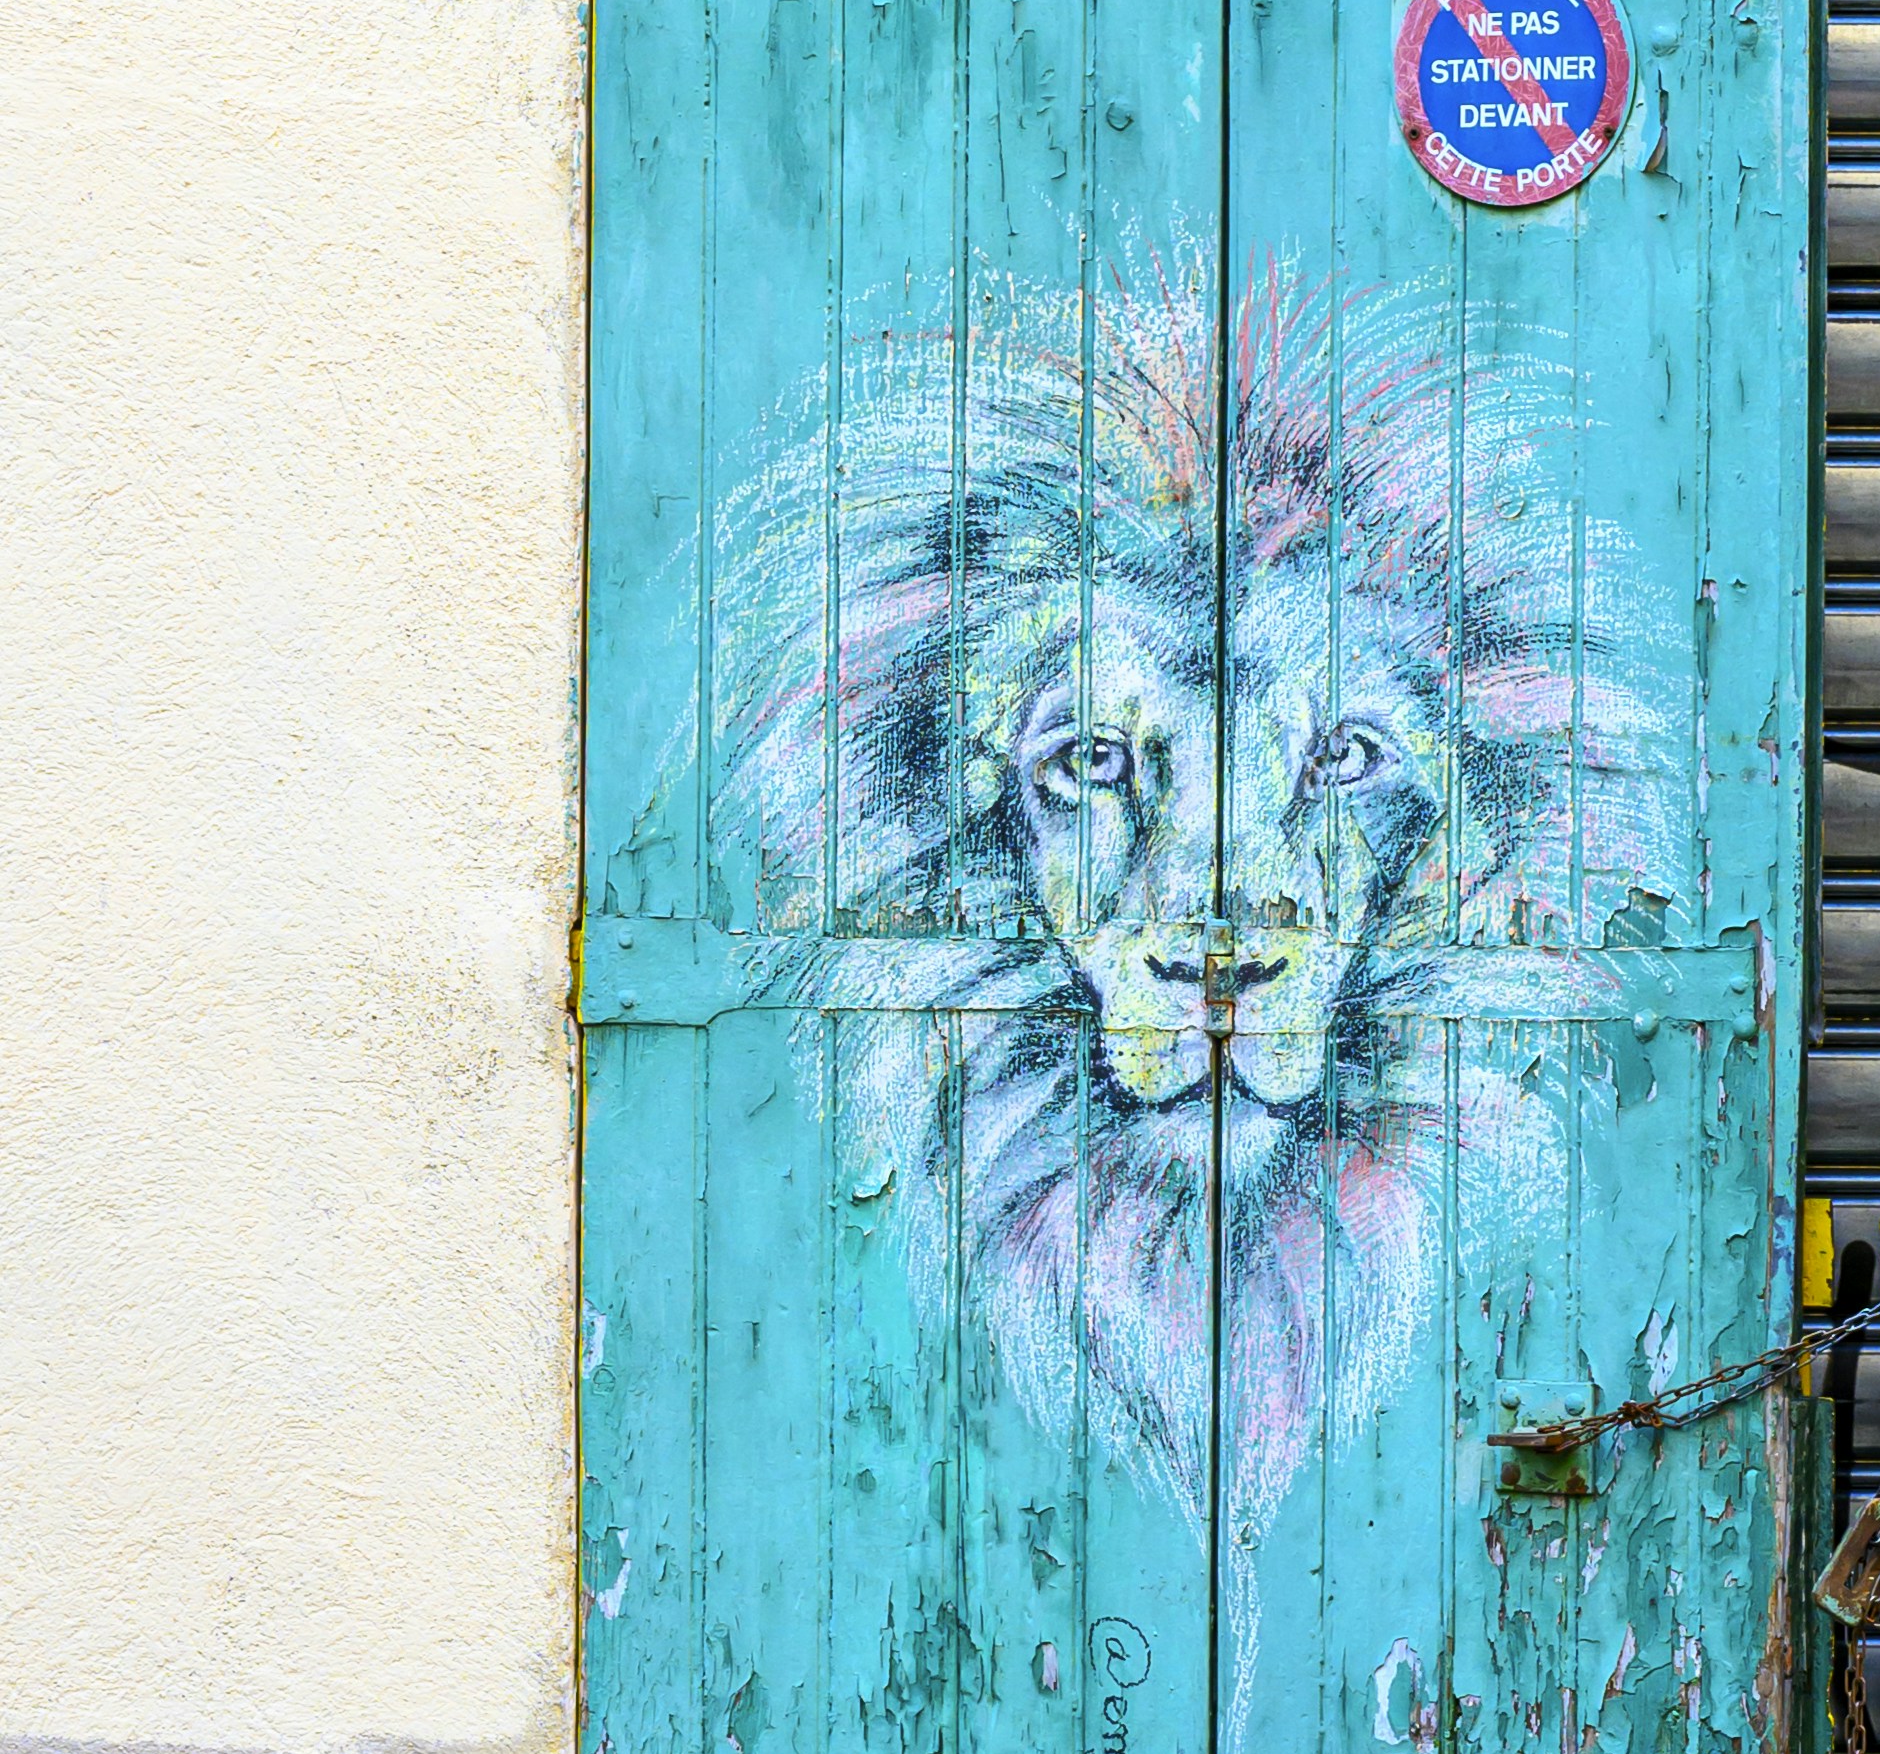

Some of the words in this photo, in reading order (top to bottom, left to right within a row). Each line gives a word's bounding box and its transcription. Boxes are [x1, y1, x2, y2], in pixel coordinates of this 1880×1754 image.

[1468, 12, 1503, 37] NE
[1510, 11, 1560, 36] PAS
[1430, 55, 1597, 84] STATIONNER
[1459, 102, 1569, 128] DEVANT
[1425, 131, 1503, 193] CETTE
[1516, 128, 1603, 193] PORTE
